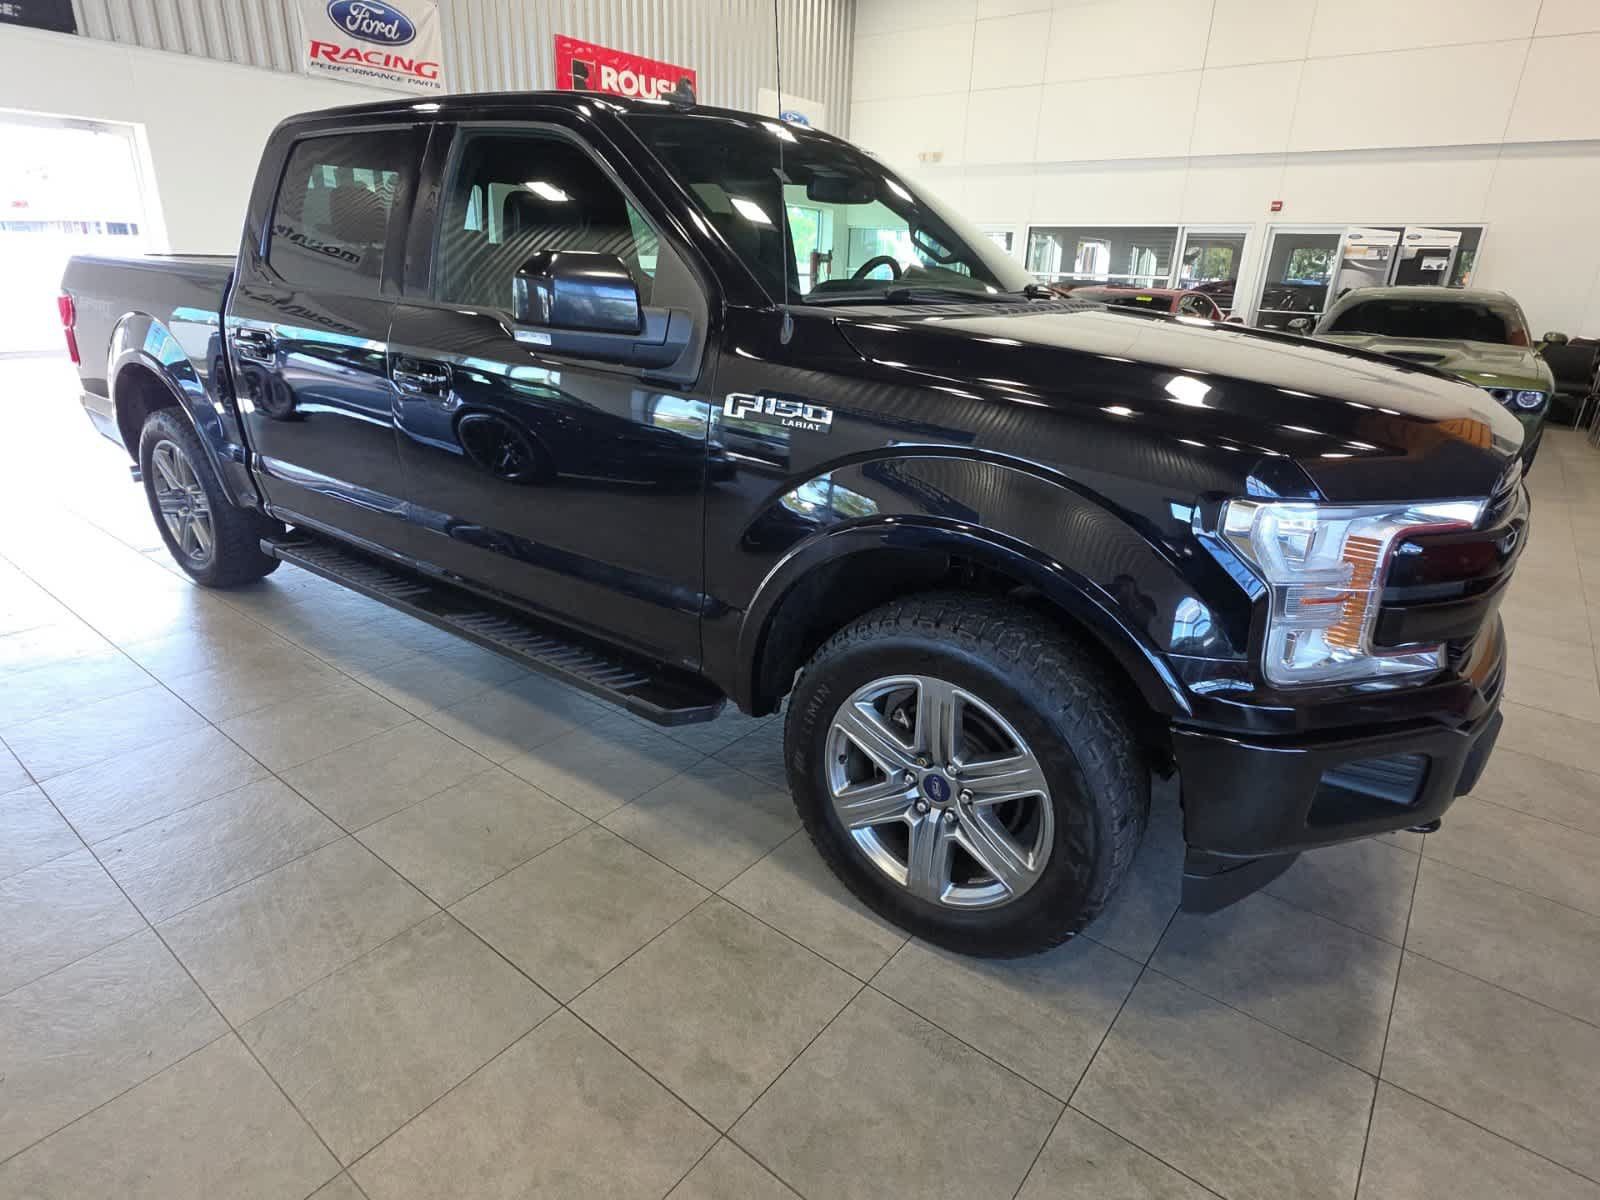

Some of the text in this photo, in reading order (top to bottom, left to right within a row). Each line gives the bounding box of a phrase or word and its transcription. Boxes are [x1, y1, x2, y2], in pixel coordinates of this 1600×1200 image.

[346, 2, 400, 40] Ford
[310, 40, 440, 80] RACING
[310, 61, 441, 89] PERFORMANCE PARTS
[781, 418, 822, 431] LARIAT
